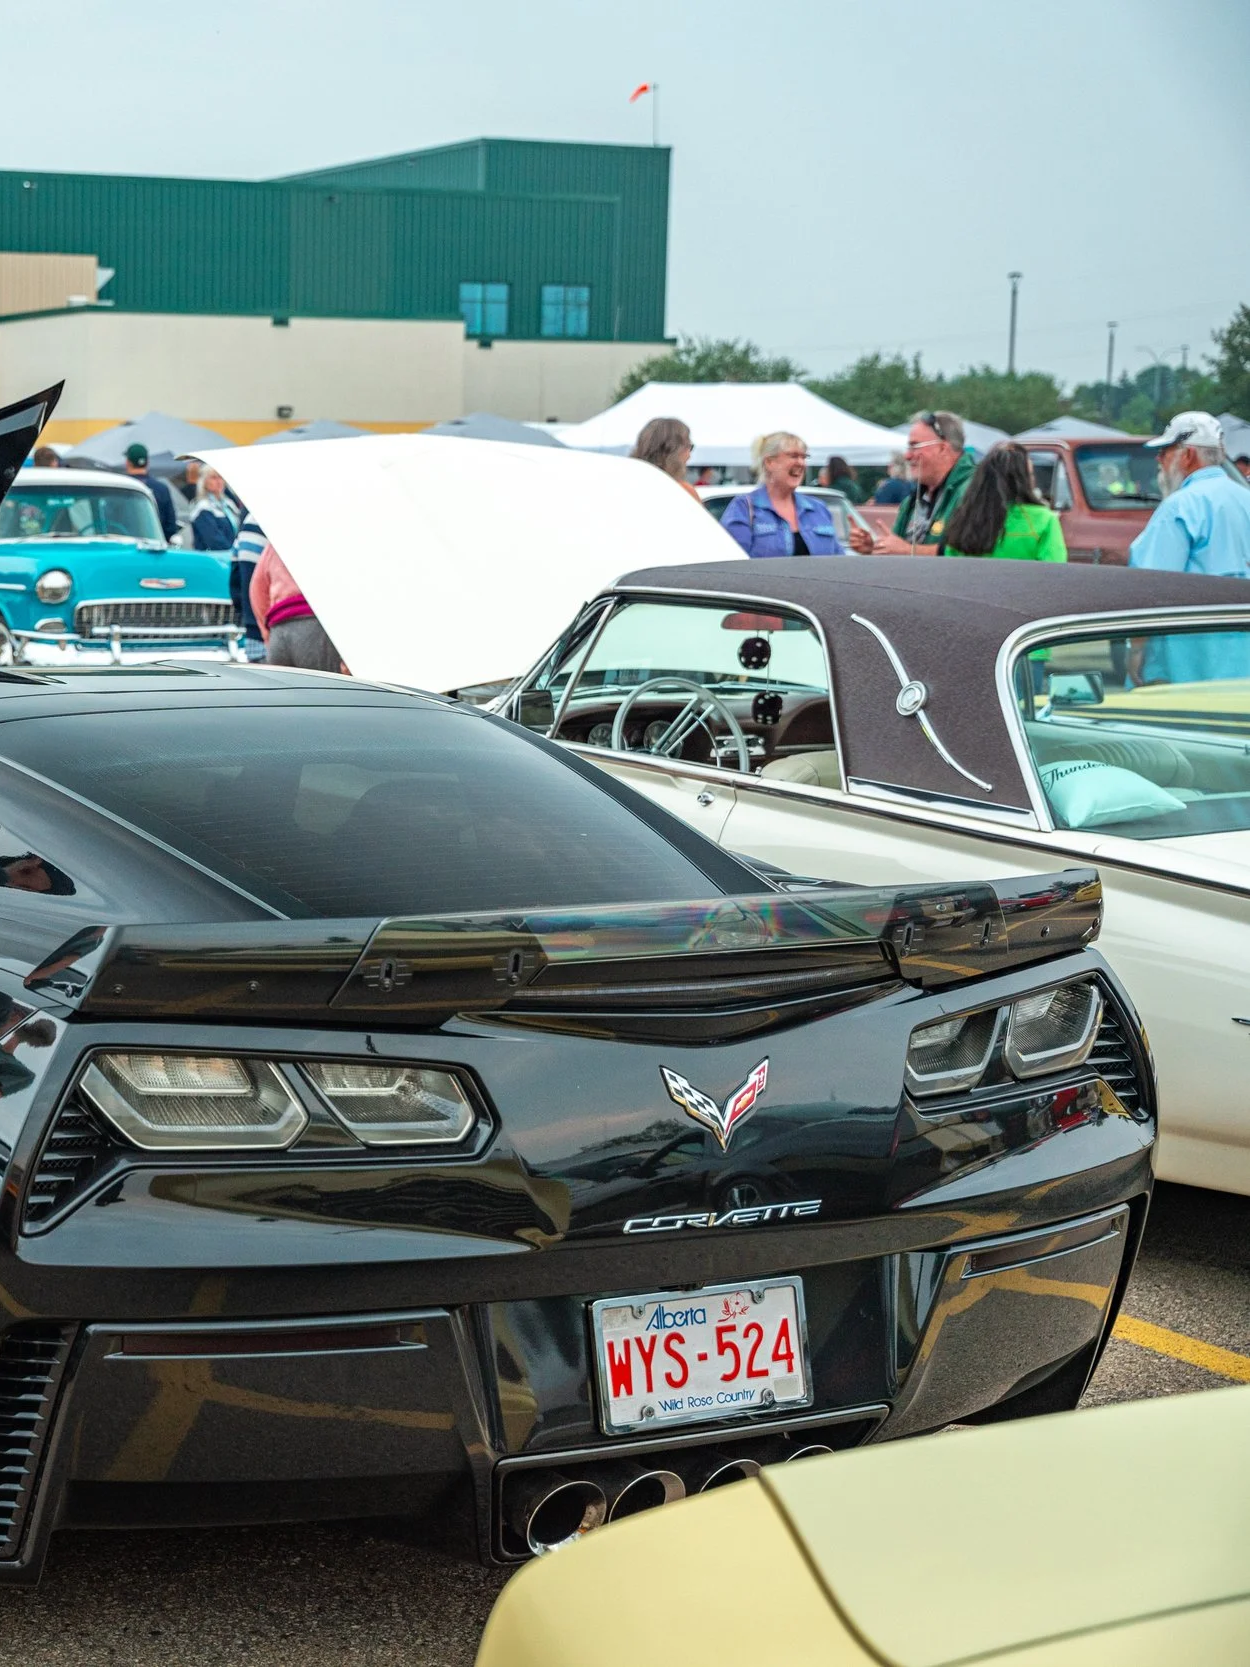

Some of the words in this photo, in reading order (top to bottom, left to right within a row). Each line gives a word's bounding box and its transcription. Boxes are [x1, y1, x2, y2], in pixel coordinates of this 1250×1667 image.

[622, 1199, 823, 1234] CORVETTE
[646, 1303, 707, 1331] Alberta
[607, 1317, 795, 1399] WYS-524
[658, 1399, 684, 1413] Wild
[688, 1395, 713, 1408] Rose
[717, 1388, 756, 1402] Country
